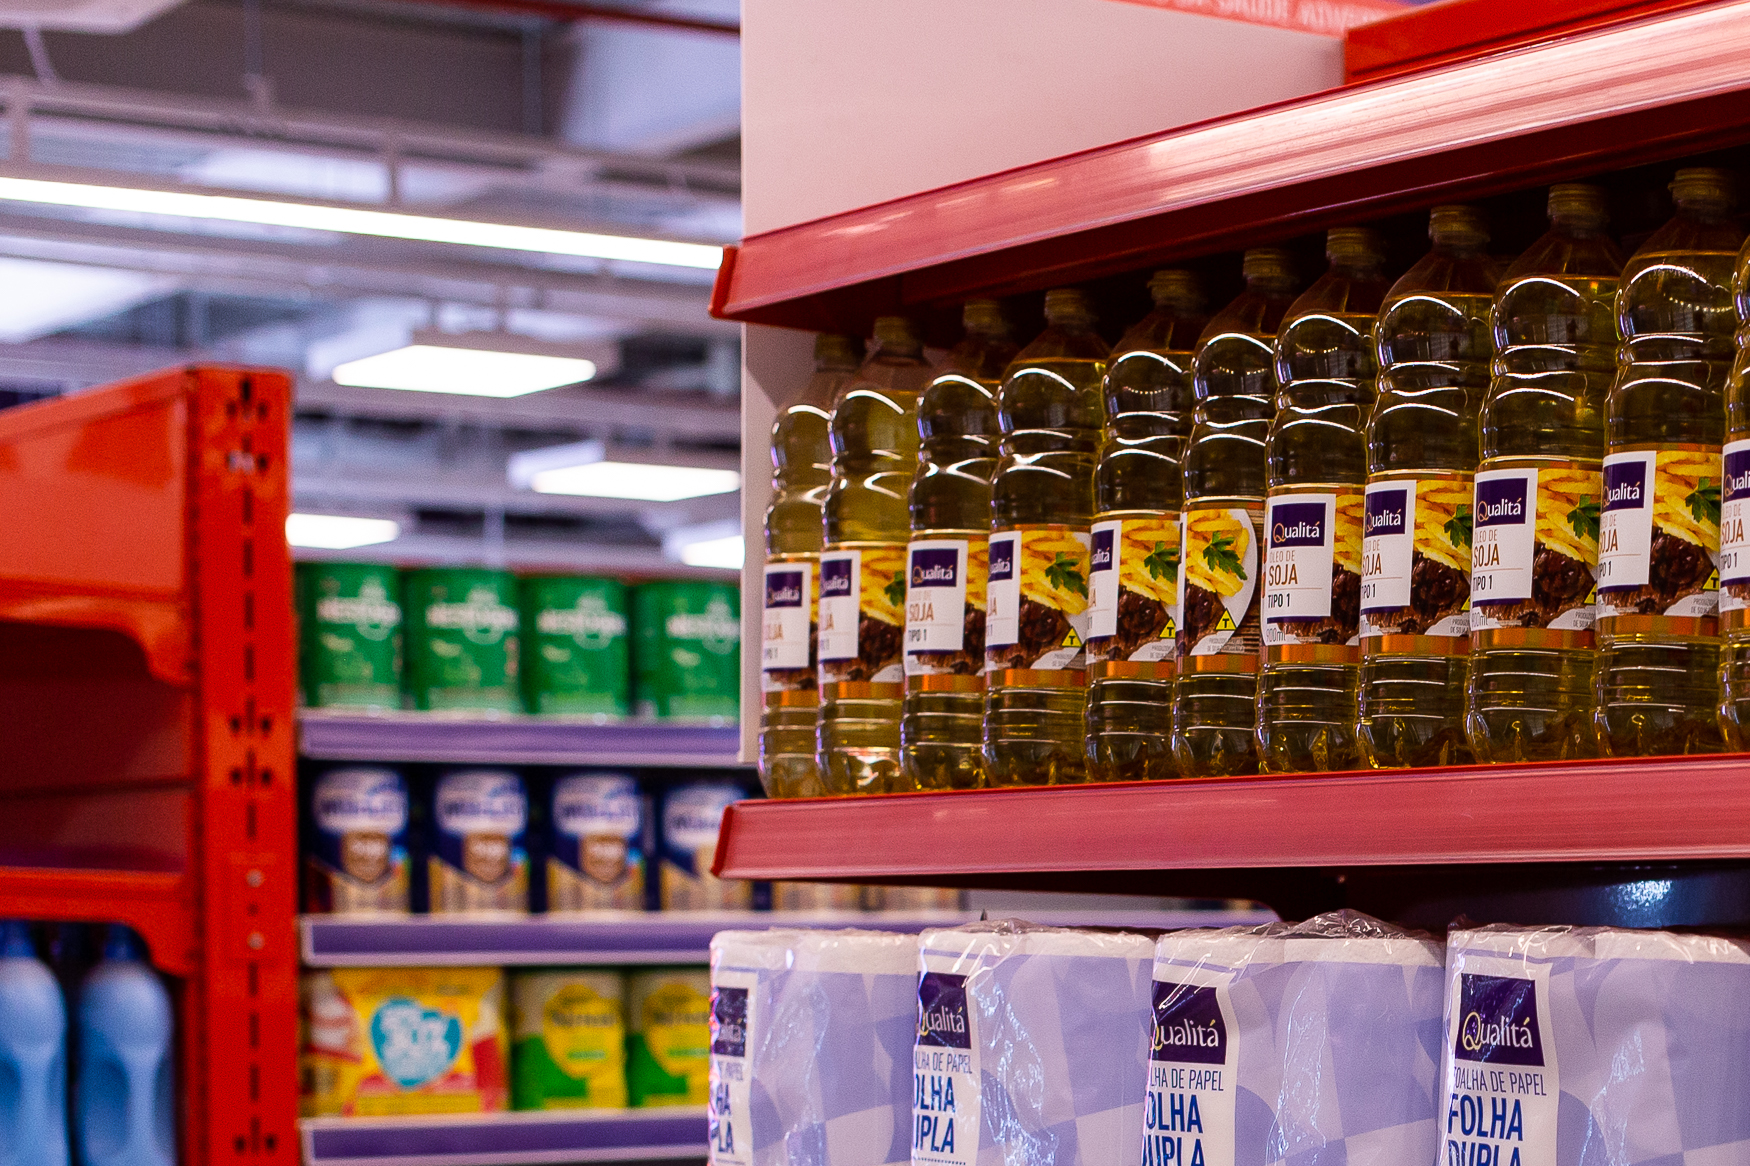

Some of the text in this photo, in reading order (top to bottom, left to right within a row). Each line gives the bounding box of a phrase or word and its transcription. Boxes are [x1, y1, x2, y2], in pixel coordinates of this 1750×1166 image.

[1603, 482, 1640, 507] Qualitá
[1365, 509, 1401, 533] Qualitá
[1478, 498, 1521, 522] Qualitá
[1273, 521, 1320, 543] Qualitá
[1489, 529, 1497, 540] DE
[1721, 519, 1744, 545] SOJA
[1286, 550, 1295, 561] DE
[1474, 544, 1499, 568] SOJA
[1734, 552, 1737, 567] 1
[912, 564, 953, 583] Qualitá
[1269, 564, 1298, 586] SOJA
[1473, 575, 1492, 591] TIPO 1
[1268, 593, 1290, 608] TIPO 1
[909, 603, 934, 622] SOJA
[1462, 1012, 1533, 1050] Qualitá
[1491, 1072, 1505, 1092] DE
[1509, 1072, 1546, 1096] PAPEL
[1448, 1093, 1524, 1142] FOLHA
